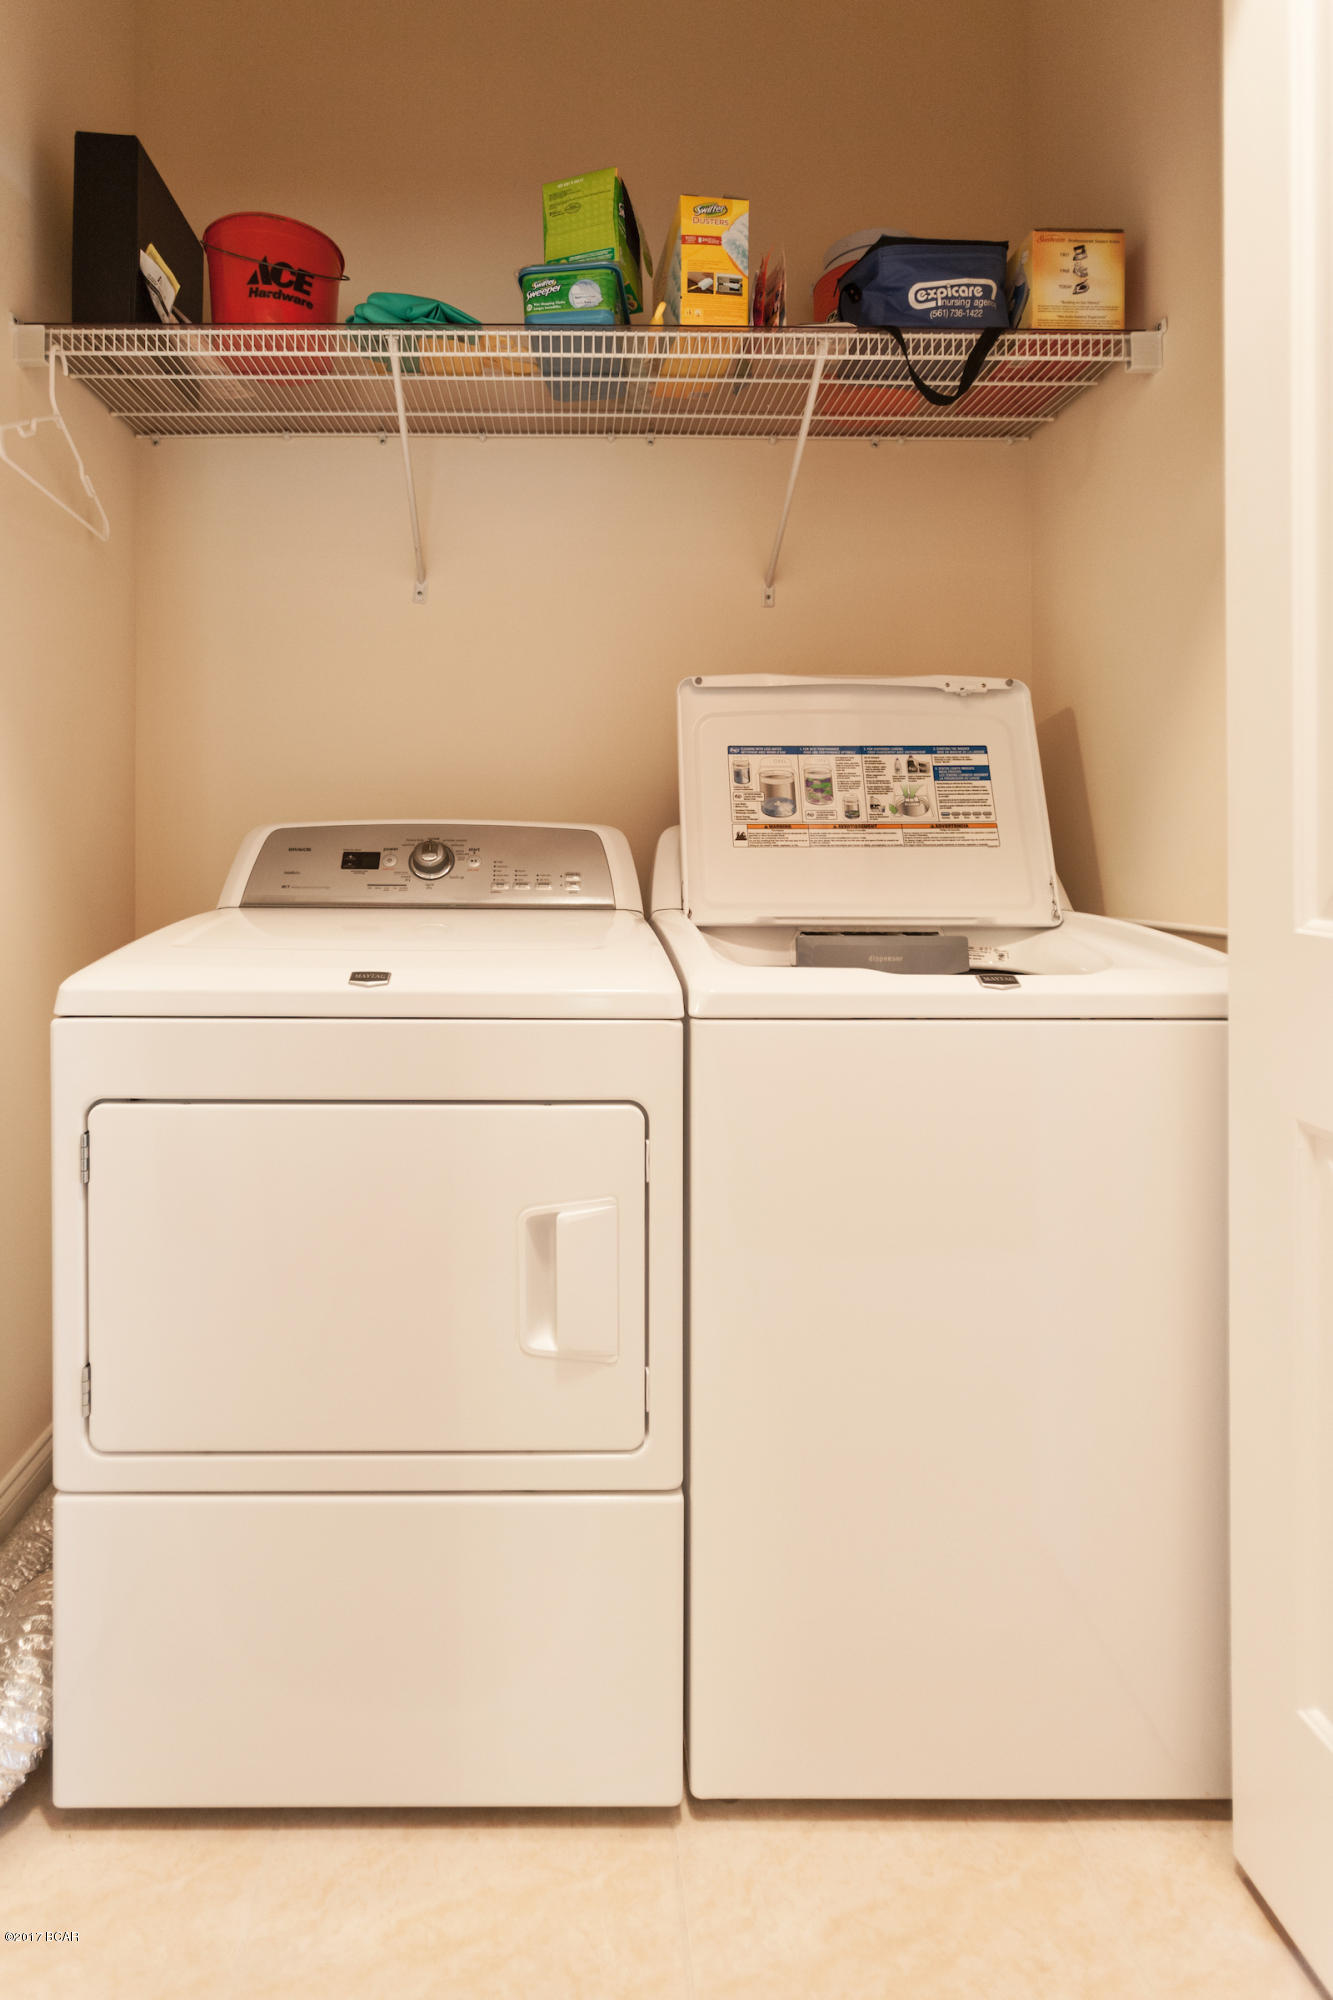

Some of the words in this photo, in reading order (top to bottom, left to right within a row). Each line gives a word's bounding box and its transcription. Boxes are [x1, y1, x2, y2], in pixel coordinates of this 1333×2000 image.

[692, 216, 729, 226] DUSTERS
[247, 256, 315, 296] ACE
[248, 287, 314, 310] Hardware
[526, 284, 562, 301] Sweeper
[916, 284, 984, 306] expicare
[941, 298, 971, 308] nursing
[929, 308, 949, 319] (561)
[950, 308, 984, 318] 736-1422
